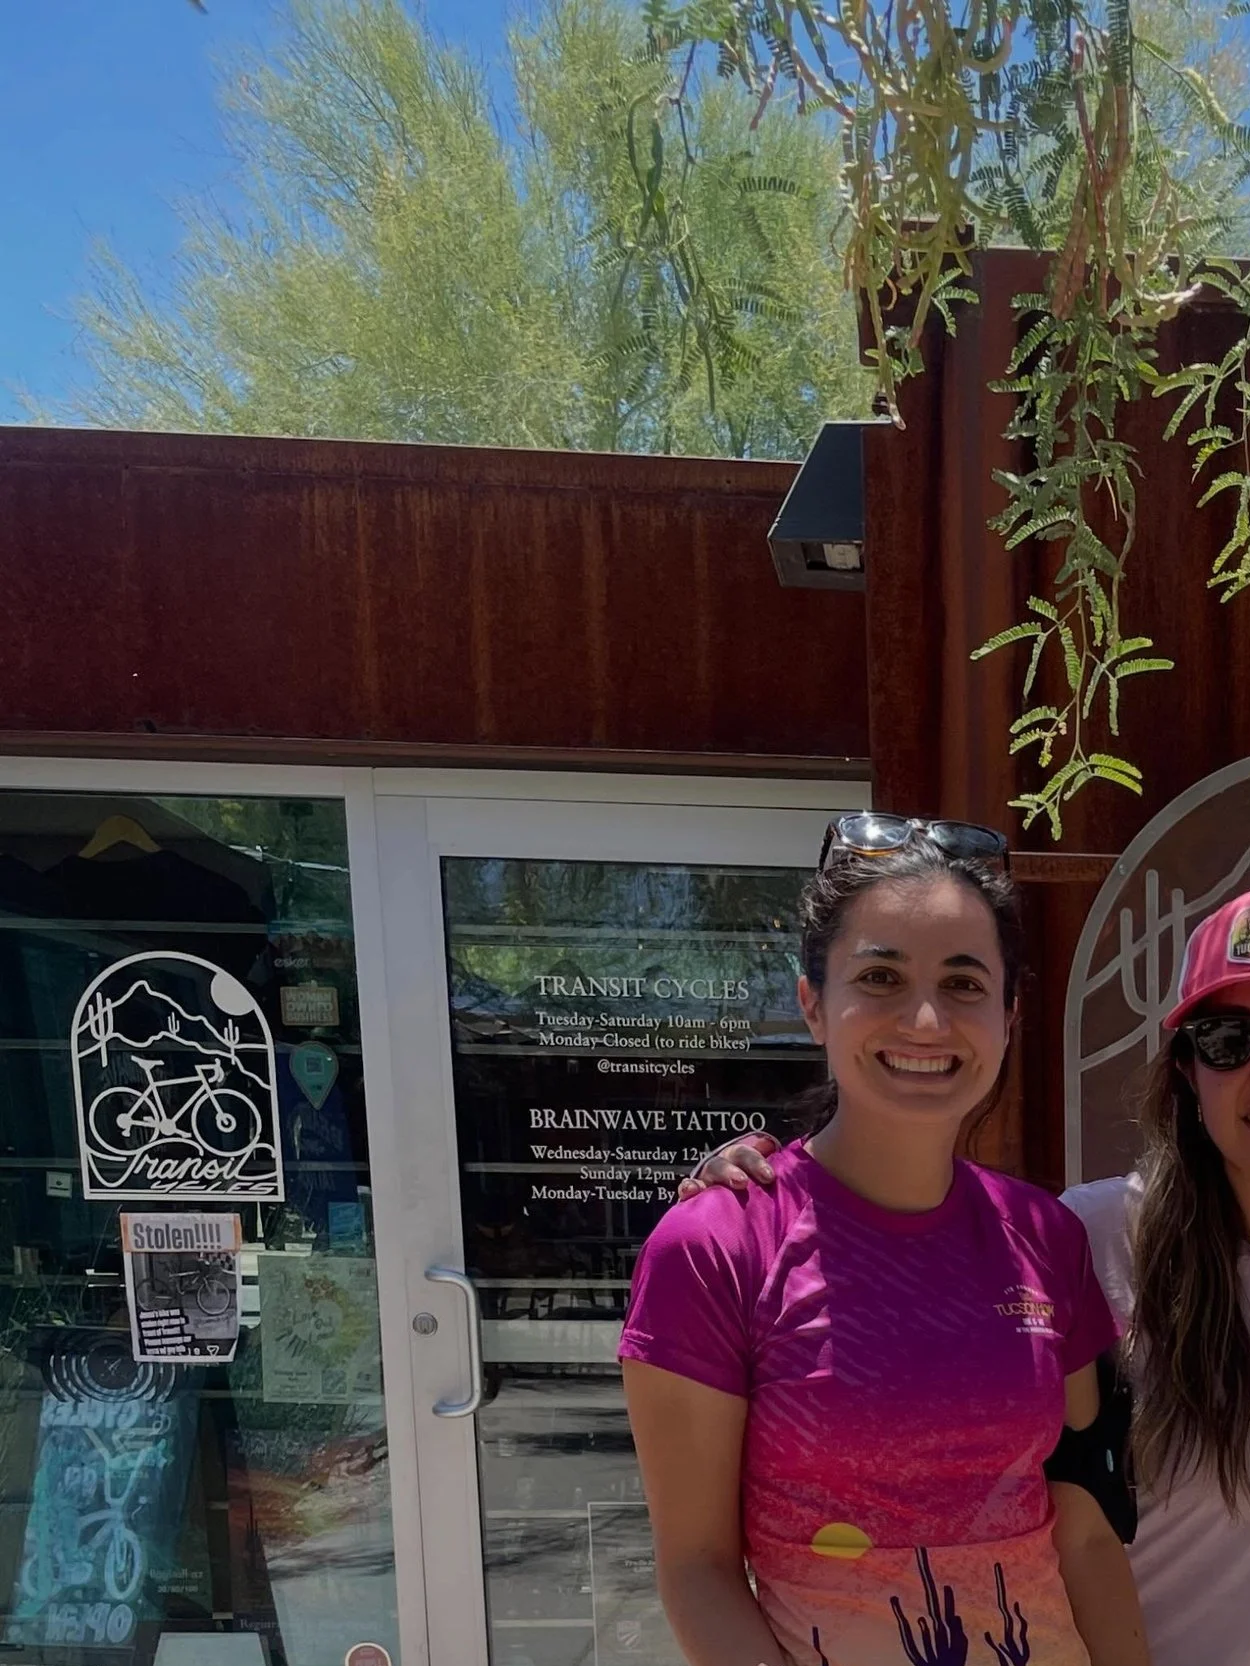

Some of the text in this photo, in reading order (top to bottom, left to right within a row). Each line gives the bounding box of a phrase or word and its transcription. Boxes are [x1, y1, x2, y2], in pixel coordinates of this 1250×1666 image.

[533, 975, 750, 1000] TRANSIT CYCLES
[535, 1011, 661, 1031] Tuesday-Saturday
[667, 1014, 706, 1029] 10am
[720, 1015, 751, 1032] 6pm
[539, 1032, 751, 1052] Monday-Closed (to ride bikes)
[597, 1059, 696, 1077] @transitcycles
[529, 1108, 766, 1132] BRAINWAVE TATTOO
[530, 1145, 712, 1164] Wednesday-Saturday 12p
[580, 1165, 632, 1183] Sunday
[637, 1167, 676, 1184] 12pm
[531, 1185, 676, 1204] Monday-Tuesday By
[133, 1222, 223, 1250] Stolen!!!!
